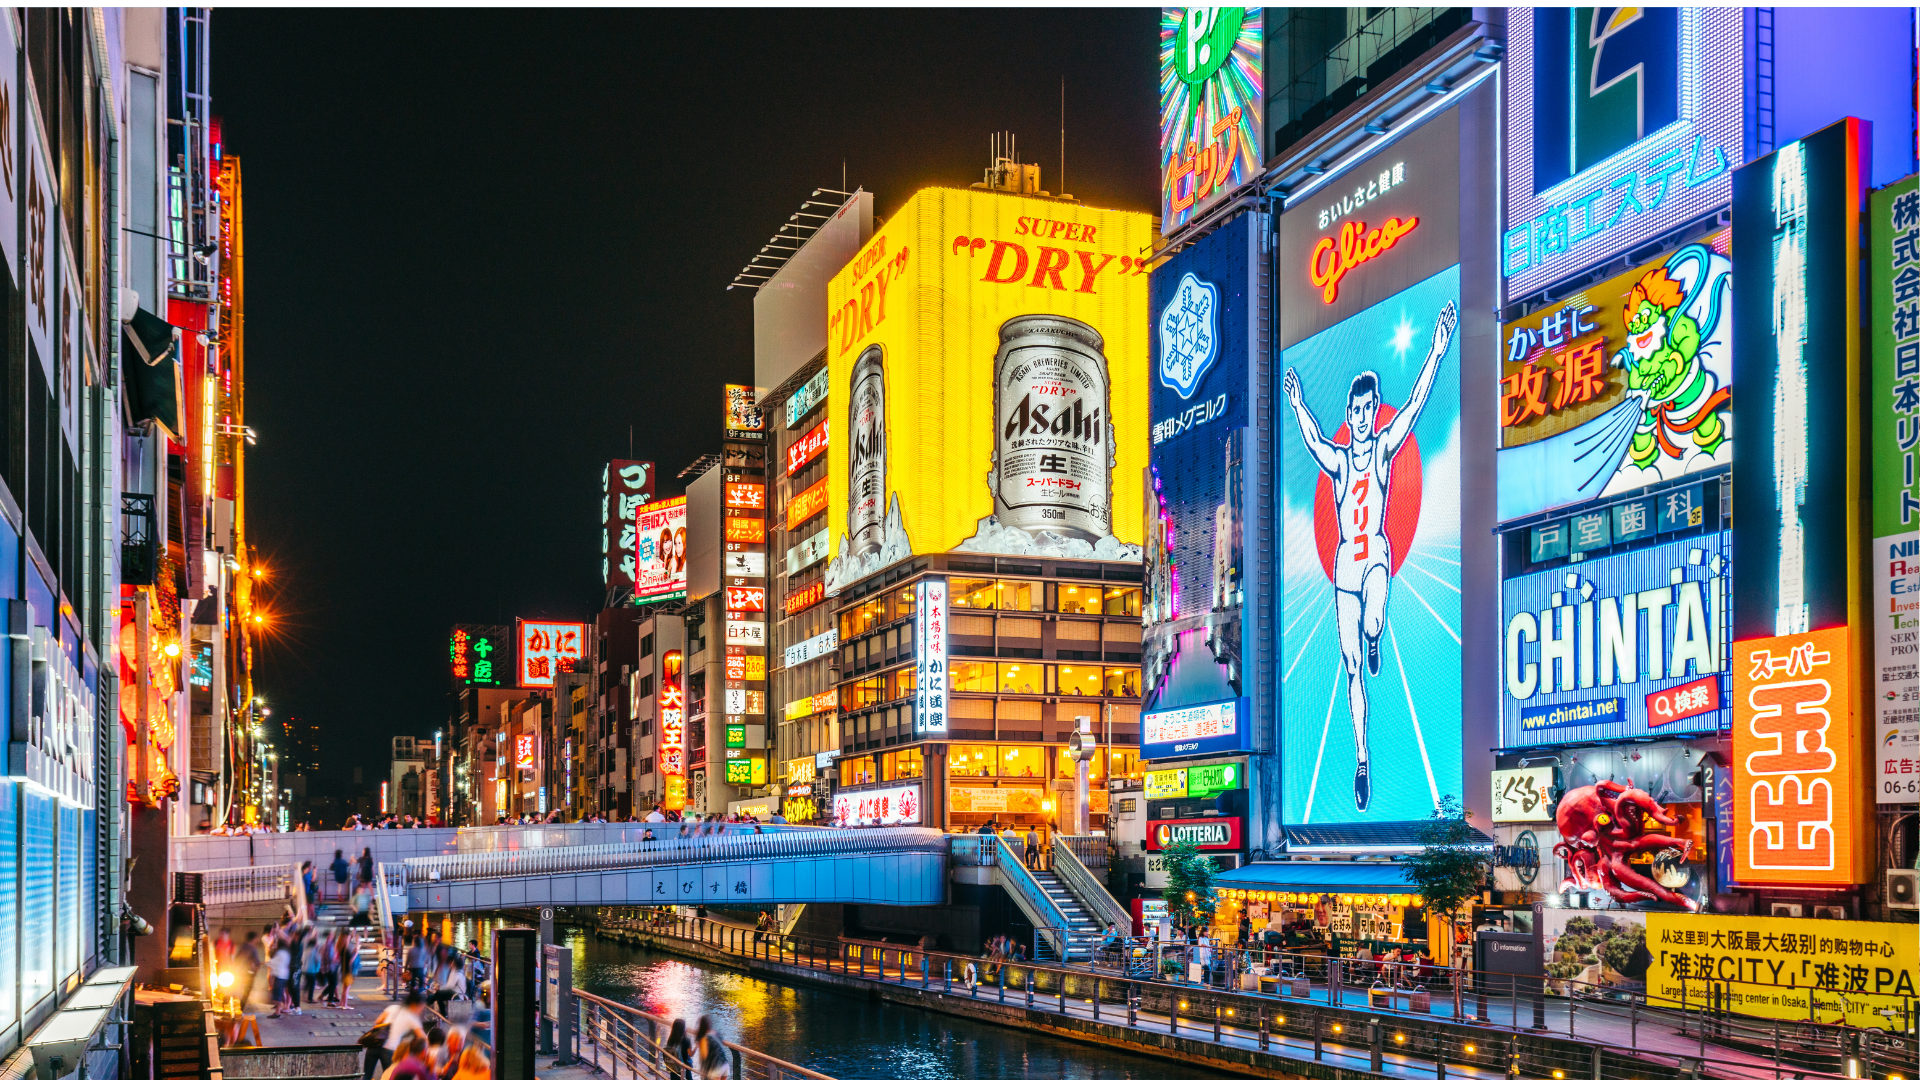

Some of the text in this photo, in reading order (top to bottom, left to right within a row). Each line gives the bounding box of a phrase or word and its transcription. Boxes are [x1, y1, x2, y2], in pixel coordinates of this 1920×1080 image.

[1170, 106, 1242, 213] ピップ
[1319, 162, 1406, 229] おいしさと健康
[1504, 135, 1726, 277] 日商エステム
[1015, 216, 1097, 243] SUPER
[852, 235, 886, 287] SUPER
[1508, 305, 1596, 362] かぜに
[1015, 357, 1090, 389] ASAHI BREWERIES LIMITED
[1500, 336, 1606, 427] 改源
[1005, 392, 1100, 446] Asahi
[1153, 393, 1227, 444] 雪印メグミルク
[852, 416, 882, 477] Asahi
[1040, 454, 1067, 474] 生
[861, 478, 871, 498] 生
[1027, 478, 1081, 490] スーパードライ
[1041, 489, 1066, 498] 生ビール
[733, 519, 749, 529] 相席
[1042, 509, 1066, 520] 350ml
[1352, 472, 1370, 562] グリコ
[1538, 489, 1701, 555] 戸堂歯科 3F
[727, 529, 764, 540] ダイニング
[727, 589, 764, 610] はや
[1890, 578, 1919, 595] Est
[727, 612, 741, 620] 4F
[930, 605, 941, 653] 本場の味
[527, 629, 577, 654] かに
[728, 625, 762, 639] 白木屋
[1507, 572, 1727, 700] CHINTAI
[453, 629, 468, 678] お好み焼
[474, 638, 493, 678] 千房
[1749, 642, 1831, 681] スーパー
[1674, 686, 1709, 713] 検索
[1883, 707, 1919, 715] 第二種金融商品
[658, 685, 683, 774] 大阪王将
[727, 750, 741, 758] B1F
[1704, 767, 1713, 798] 2F
[1745, 679, 1837, 870] 玉出
[1884, 780, 1919, 793] 06-6
[1503, 775, 1540, 813] くくる
[1171, 825, 1224, 842] LOTTERIA
[656, 881, 747, 895] えびす橋
[1333, 918, 1351, 931] お好み
[1360, 919, 1392, 935] 兄貴の店
[1499, 943, 1527, 952] information
[1661, 929, 1895, 959] 从这里到大阪最大级别的购物中心
[1746, 993, 1770, 1005] center
[1772, 993, 1780, 1005] in
[1782, 995, 1809, 1009] Osaka,
